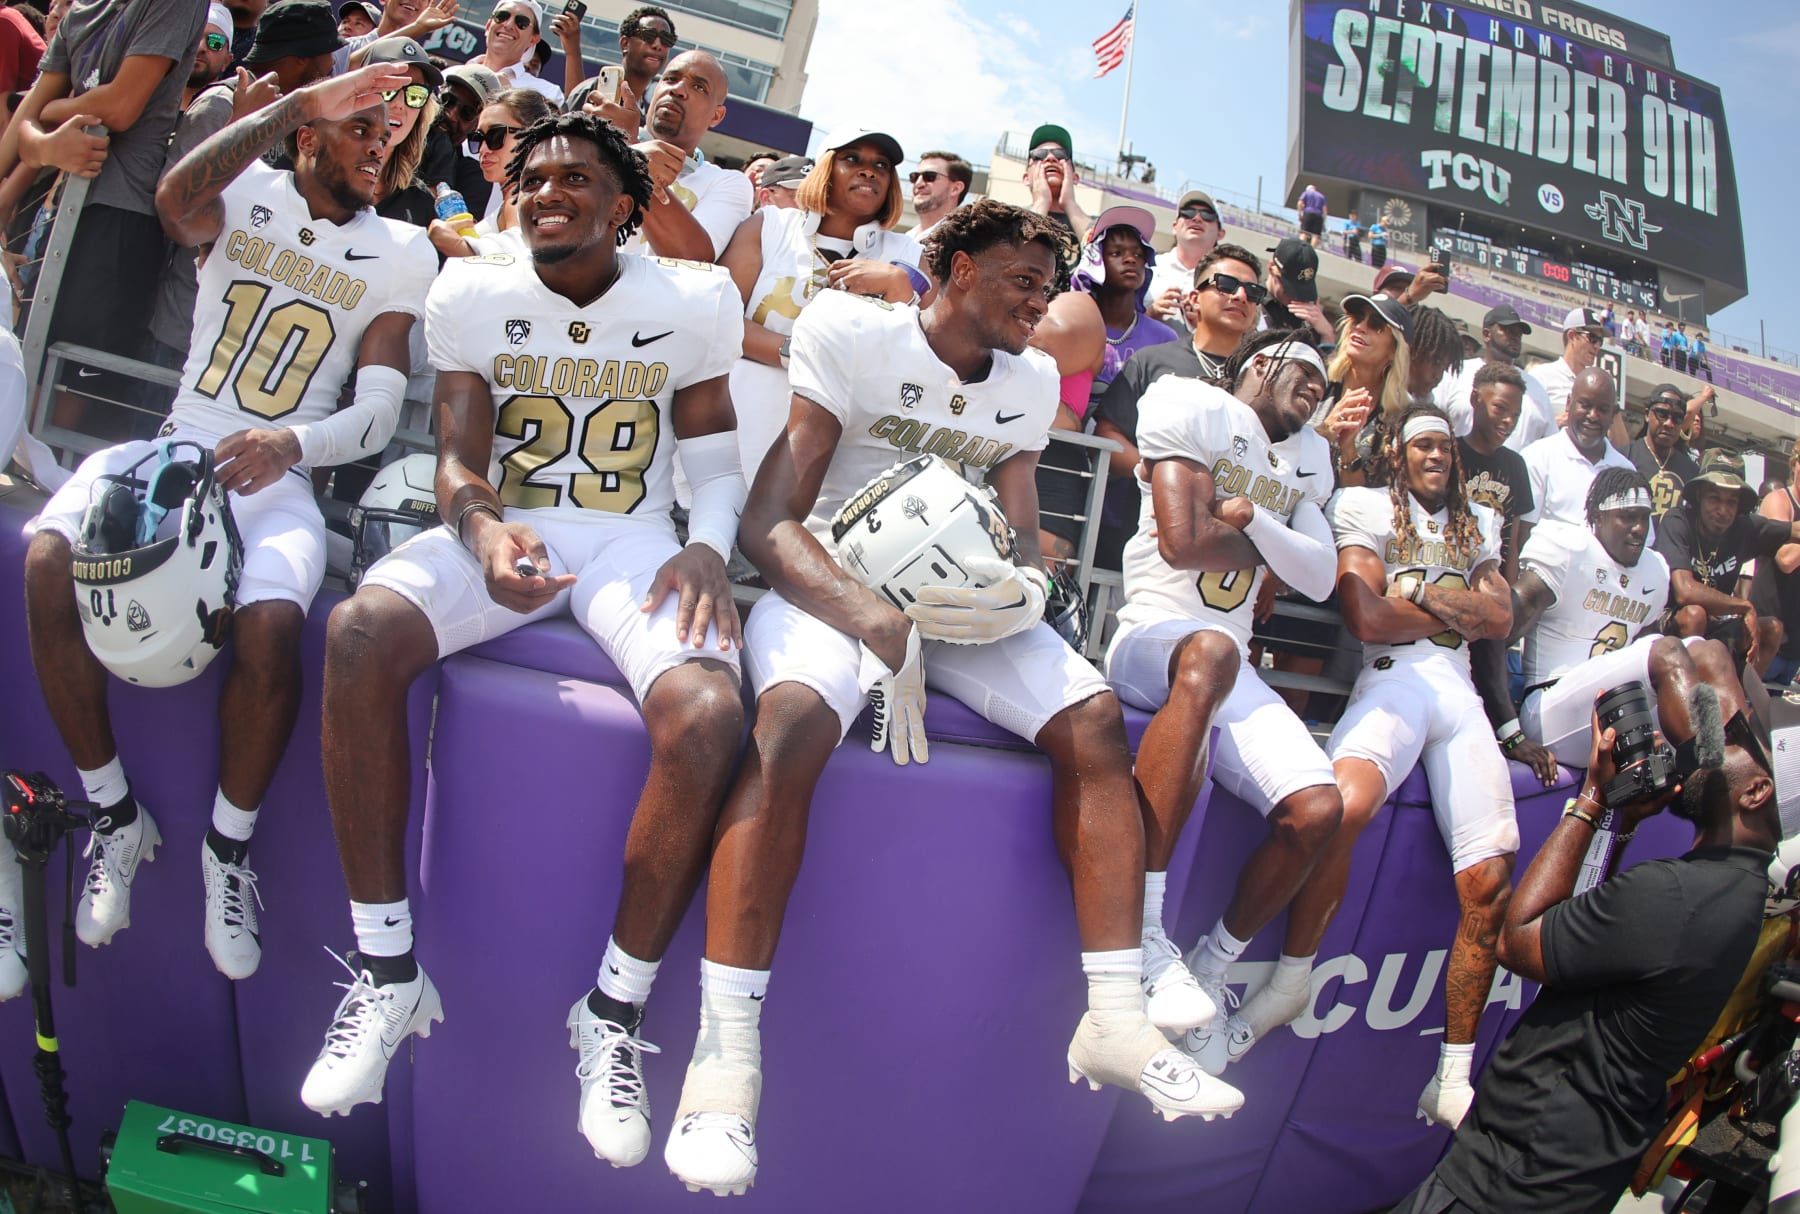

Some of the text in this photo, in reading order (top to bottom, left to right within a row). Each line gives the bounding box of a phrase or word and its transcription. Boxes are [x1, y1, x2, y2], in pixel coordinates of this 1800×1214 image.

[423, 22, 478, 55] TCU
[1541, 6, 1628, 51] FROGS
[1369, 0, 1677, 101] NEXT HOME GAME
[1323, 8, 1718, 217] SEPTEMBER 9TH
[1421, 150, 1512, 204] TCU
[1542, 189, 1561, 207] VS
[251, 204, 273, 222] PAC
[251, 216, 265, 229] 12
[1434, 236, 1475, 254] 42 TCU
[225, 229, 367, 311] COLORADO
[1478, 250, 1526, 274] 0 2 10
[1543, 262, 1569, 282] 0:00
[1576, 276, 1589, 290] 47
[1612, 286, 1619, 300] 2
[1622, 282, 1655, 307] CU 45
[505, 319, 531, 339] PAC
[509, 332, 524, 345] 12
[193, 280, 337, 422] 10
[494, 353, 669, 399] COLORADO
[901, 383, 923, 402] PAC
[902, 396, 916, 408] 12
[494, 394, 660, 515] 29
[869, 415, 1013, 469] COLORADO
[411, 500, 436, 513] BUFFS
[841, 479, 889, 525] COLORADO
[866, 508, 882, 533] 3
[72, 557, 132, 579] COLORADO
[90, 589, 118, 618] 10
[1601, 808, 1614, 830] TCU
[157, 1115, 315, 1162] 11035037
